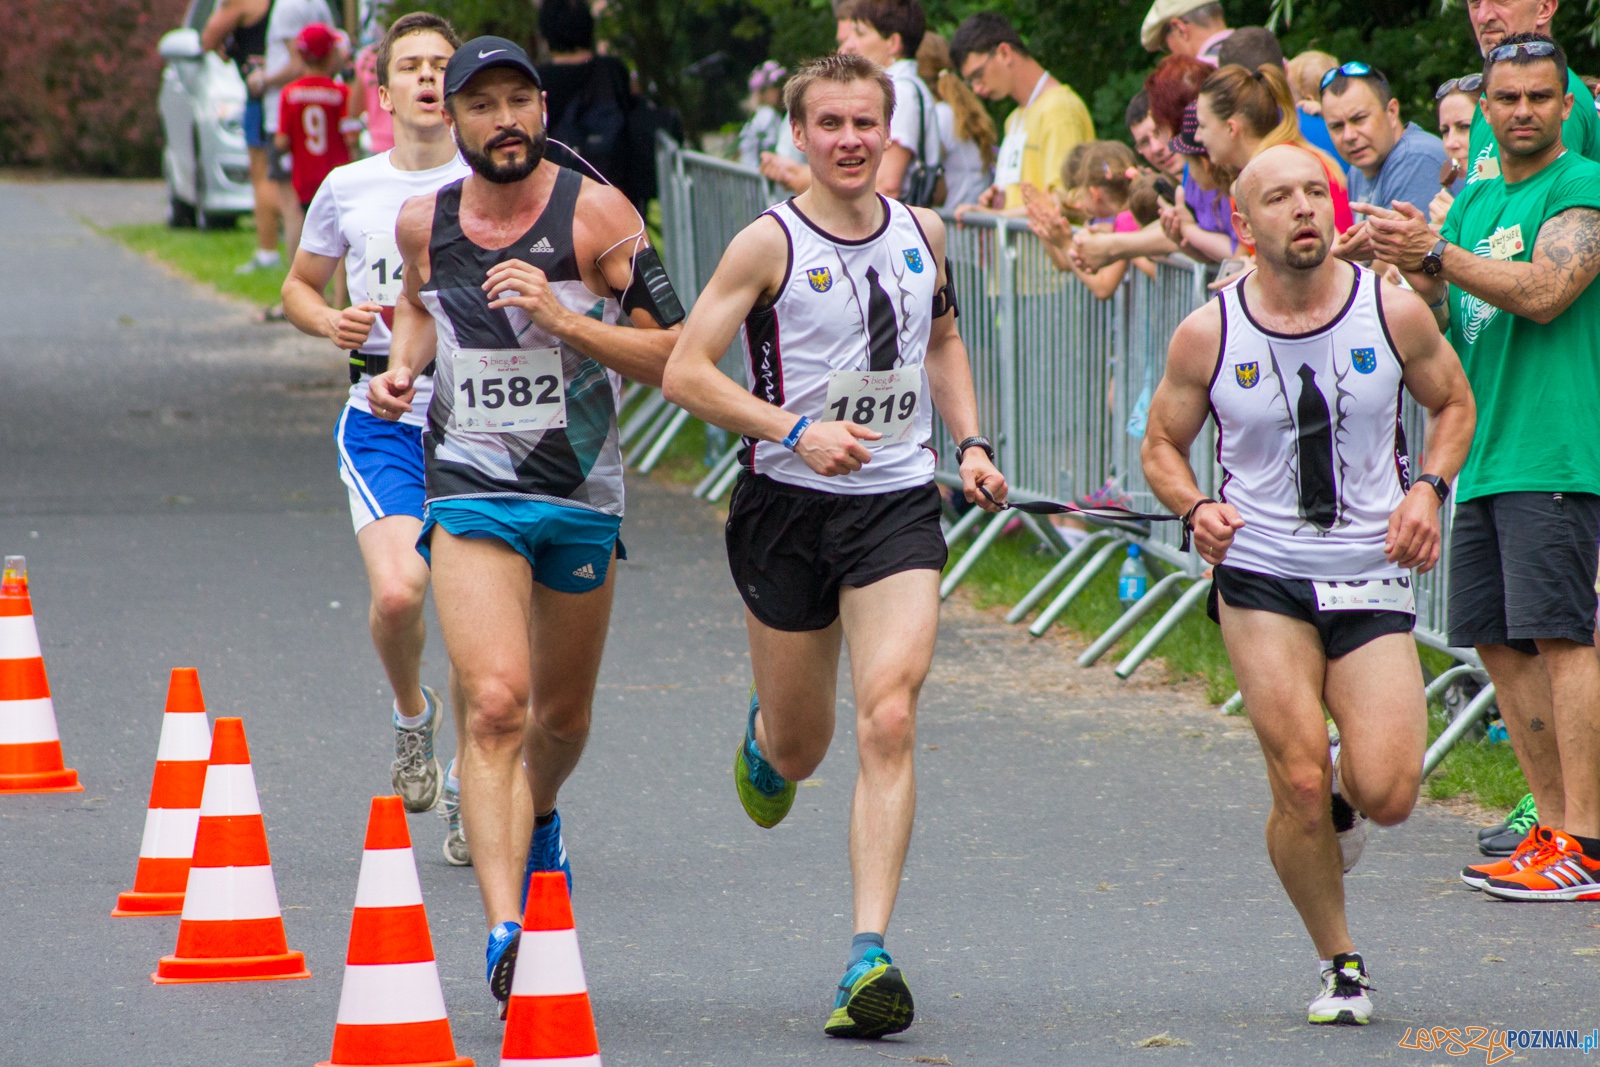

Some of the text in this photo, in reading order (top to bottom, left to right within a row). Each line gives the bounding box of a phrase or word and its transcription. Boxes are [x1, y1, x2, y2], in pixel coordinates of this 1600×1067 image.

[301, 104, 328, 157] 9
[479, 355, 511, 374] 5 bieg
[460, 375, 560, 409] 1582
[830, 391, 917, 424] 1819
[572, 570, 596, 580] adidas
